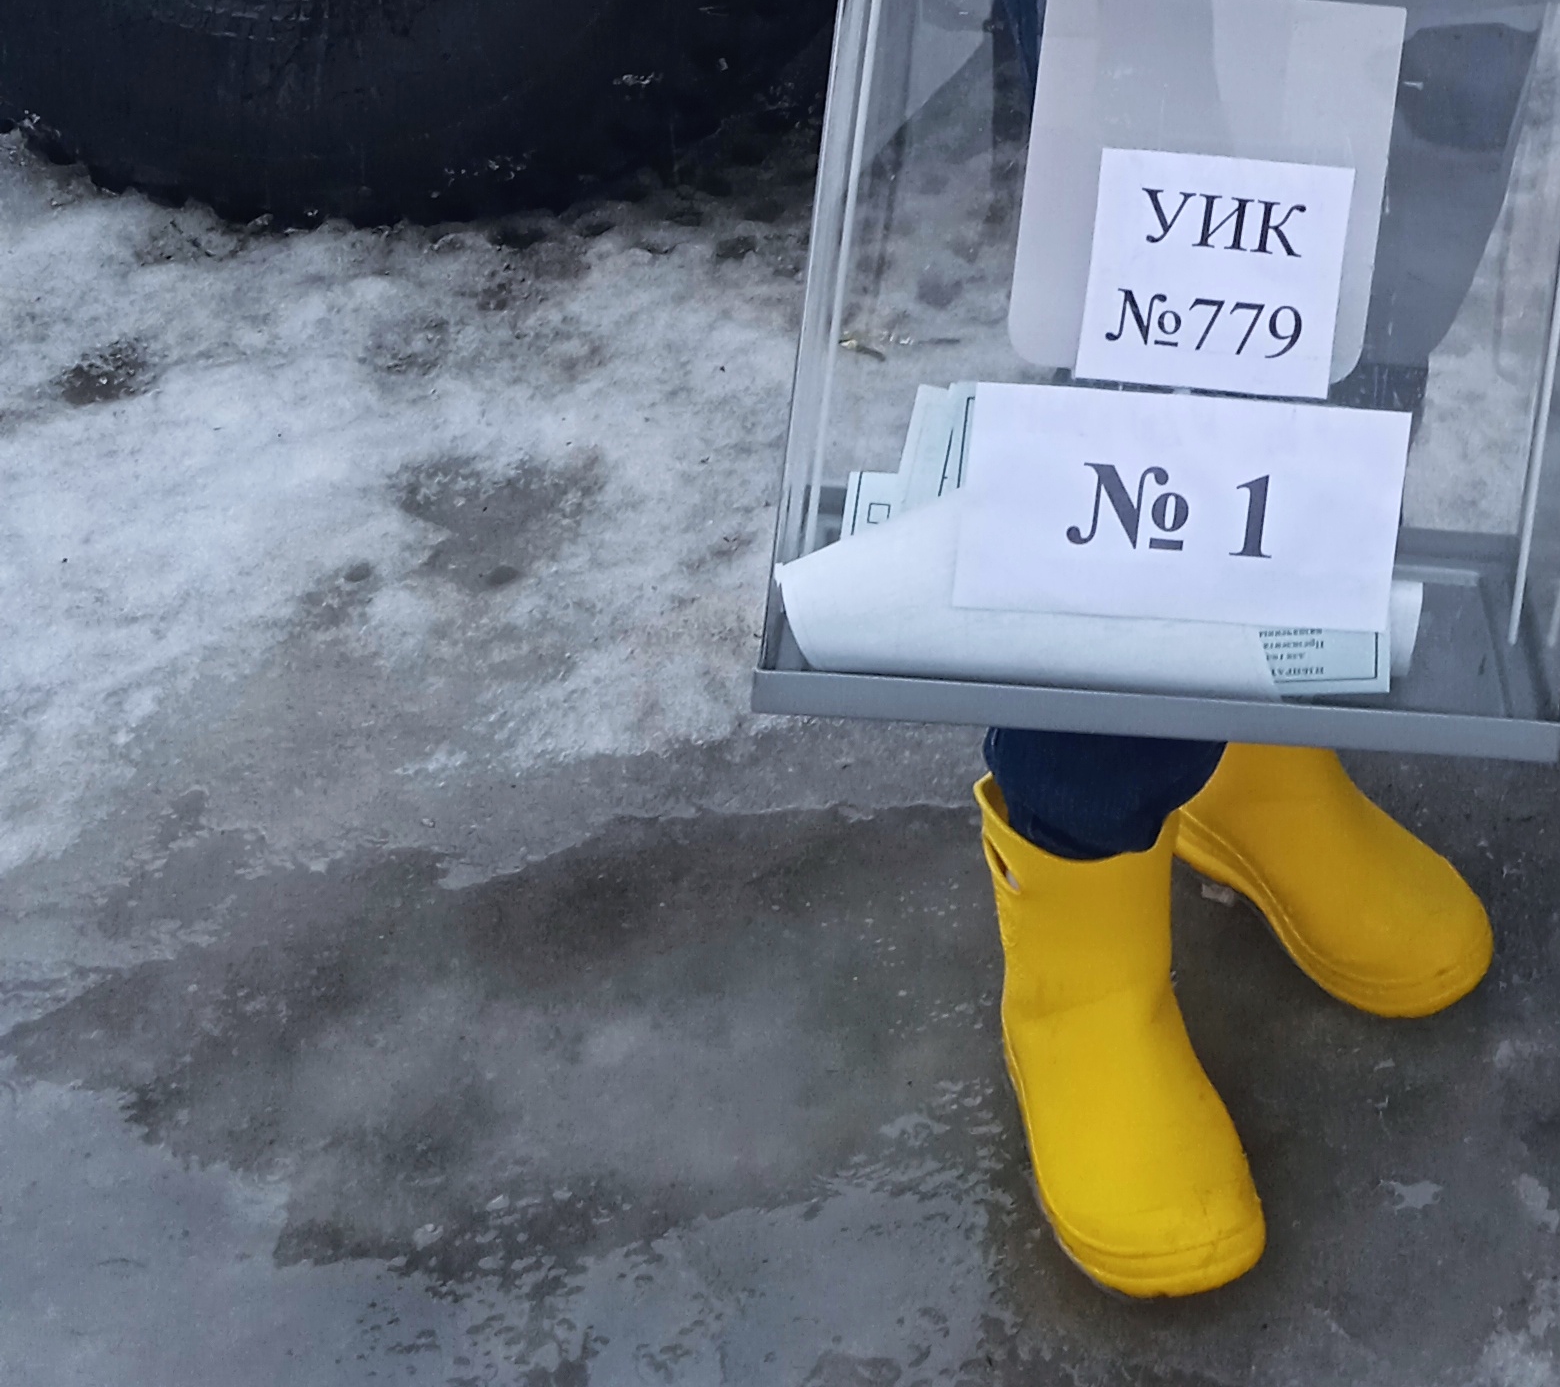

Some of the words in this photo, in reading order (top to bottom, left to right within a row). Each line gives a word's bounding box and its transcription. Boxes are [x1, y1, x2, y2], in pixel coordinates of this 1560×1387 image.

[1142, 187, 1306, 258] УИК
[1105, 288, 1303, 359] №779
[1066, 462, 1189, 551] №
[1229, 474, 1272, 559] 1
